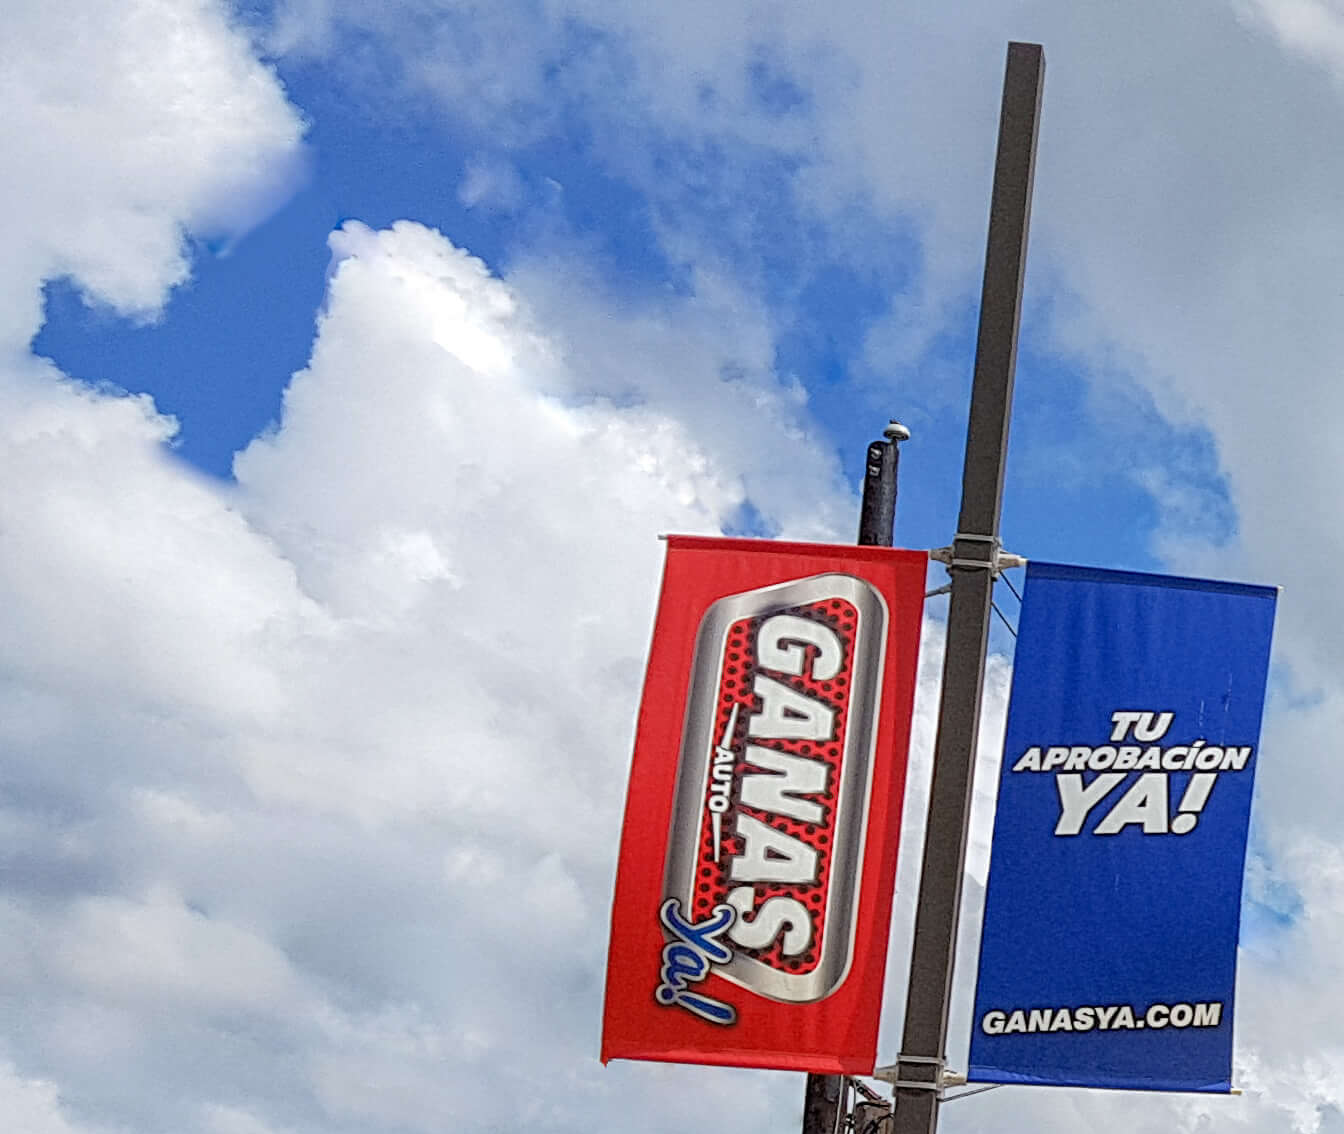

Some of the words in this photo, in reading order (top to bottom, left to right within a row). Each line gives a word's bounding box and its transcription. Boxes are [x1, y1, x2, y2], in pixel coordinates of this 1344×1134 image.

[1012, 740, 1253, 772] APROBACÍON
[1110, 711, 1175, 742] TU
[708, 745, 733, 813] AUTO
[728, 614, 844, 957] GANAS
[1053, 772, 1218, 836] YA!
[655, 898, 738, 1026] Ya!
[981, 1002, 1223, 1035] GANASYA.COM
